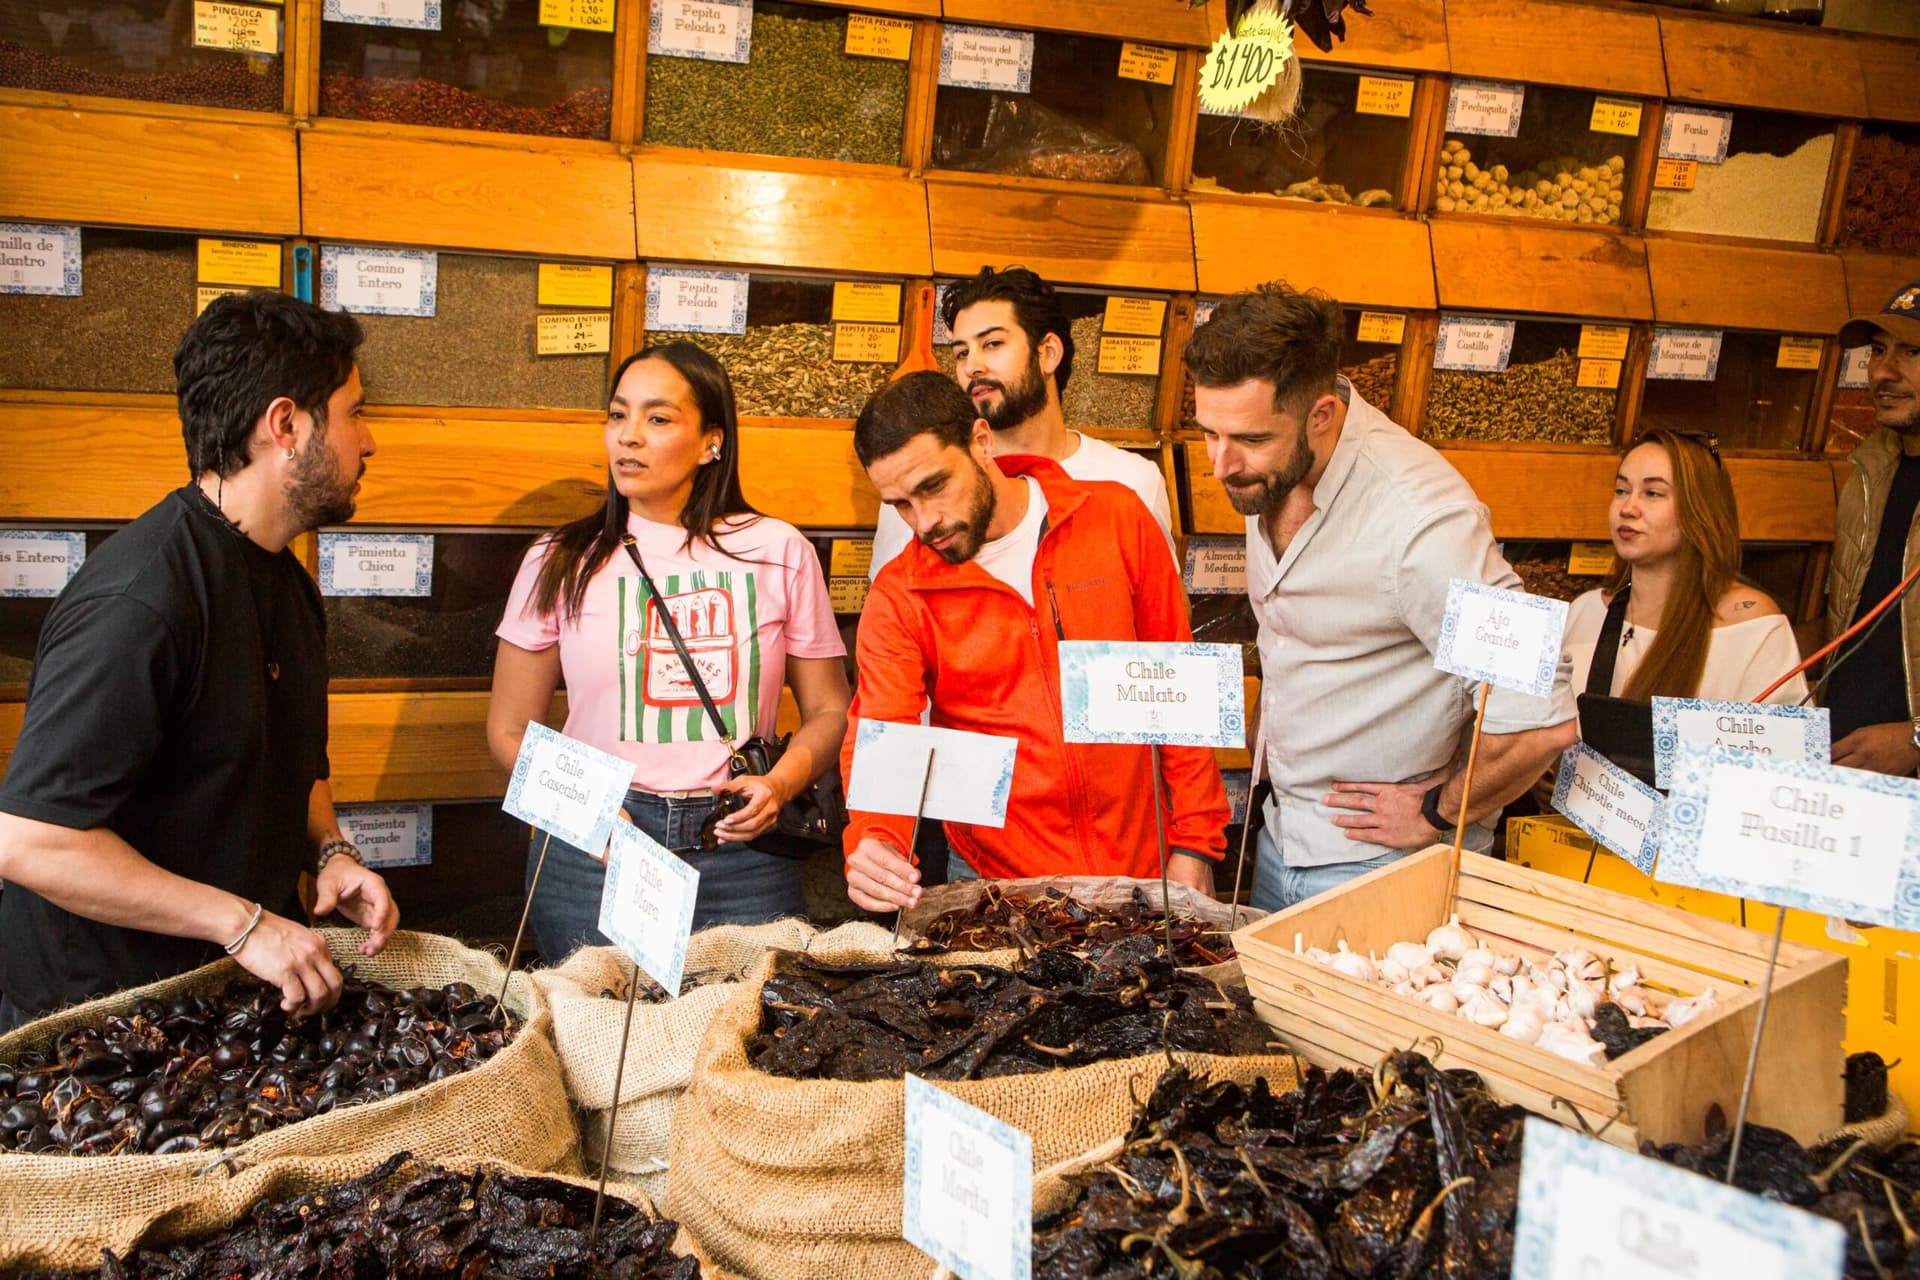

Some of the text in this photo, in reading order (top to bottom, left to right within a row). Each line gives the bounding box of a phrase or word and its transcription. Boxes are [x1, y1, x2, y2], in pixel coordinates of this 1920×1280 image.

[681, 4, 720, 20] Pepita
[674, 18, 726, 34] Pelada 2
[963, 41, 1011, 54] Sal rosa del
[954, 51, 992, 65] Himalaya
[1475, 89, 1497, 102] Soya
[1683, 123, 1709, 136] Panko
[37, 238, 53, 251] de
[0, 253, 46, 267] lantro
[357, 260, 405, 274] Comino
[358, 275, 402, 289] Entero
[679, 281, 718, 298] Pepita
[677, 295, 718, 308] Pelada
[539, 315, 609, 324] COMINO ENTERO
[840, 325, 866, 333] PEPITA
[1458, 327, 1494, 339] Nuez de
[1456, 340, 1489, 351] Castilla
[1692, 340, 1702, 348] de
[1660, 349, 1706, 361] Macadamia
[16, 550, 66, 563] Entero
[348, 545, 406, 558] Pimienta
[359, 560, 395, 571] Chica
[1204, 563, 1245, 573] Mediana
[1488, 608, 1510, 630] Ajo
[1475, 626, 1520, 650] Grande
[657, 655, 721, 678] SARNES
[1125, 661, 1176, 680] Chile
[1116, 684, 1187, 703] Mulato
[1716, 716, 1765, 735] Chile
[555, 753, 585, 779] Chile
[1598, 773, 1625, 800] Chile
[1573, 773, 1646, 832] Chipotle meco
[1769, 784, 1845, 820] Chile
[348, 818, 406, 831] Pimienta
[354, 832, 400, 845] Grande
[1738, 811, 1864, 857] Pasilla 1
[639, 858, 663, 892] Chile
